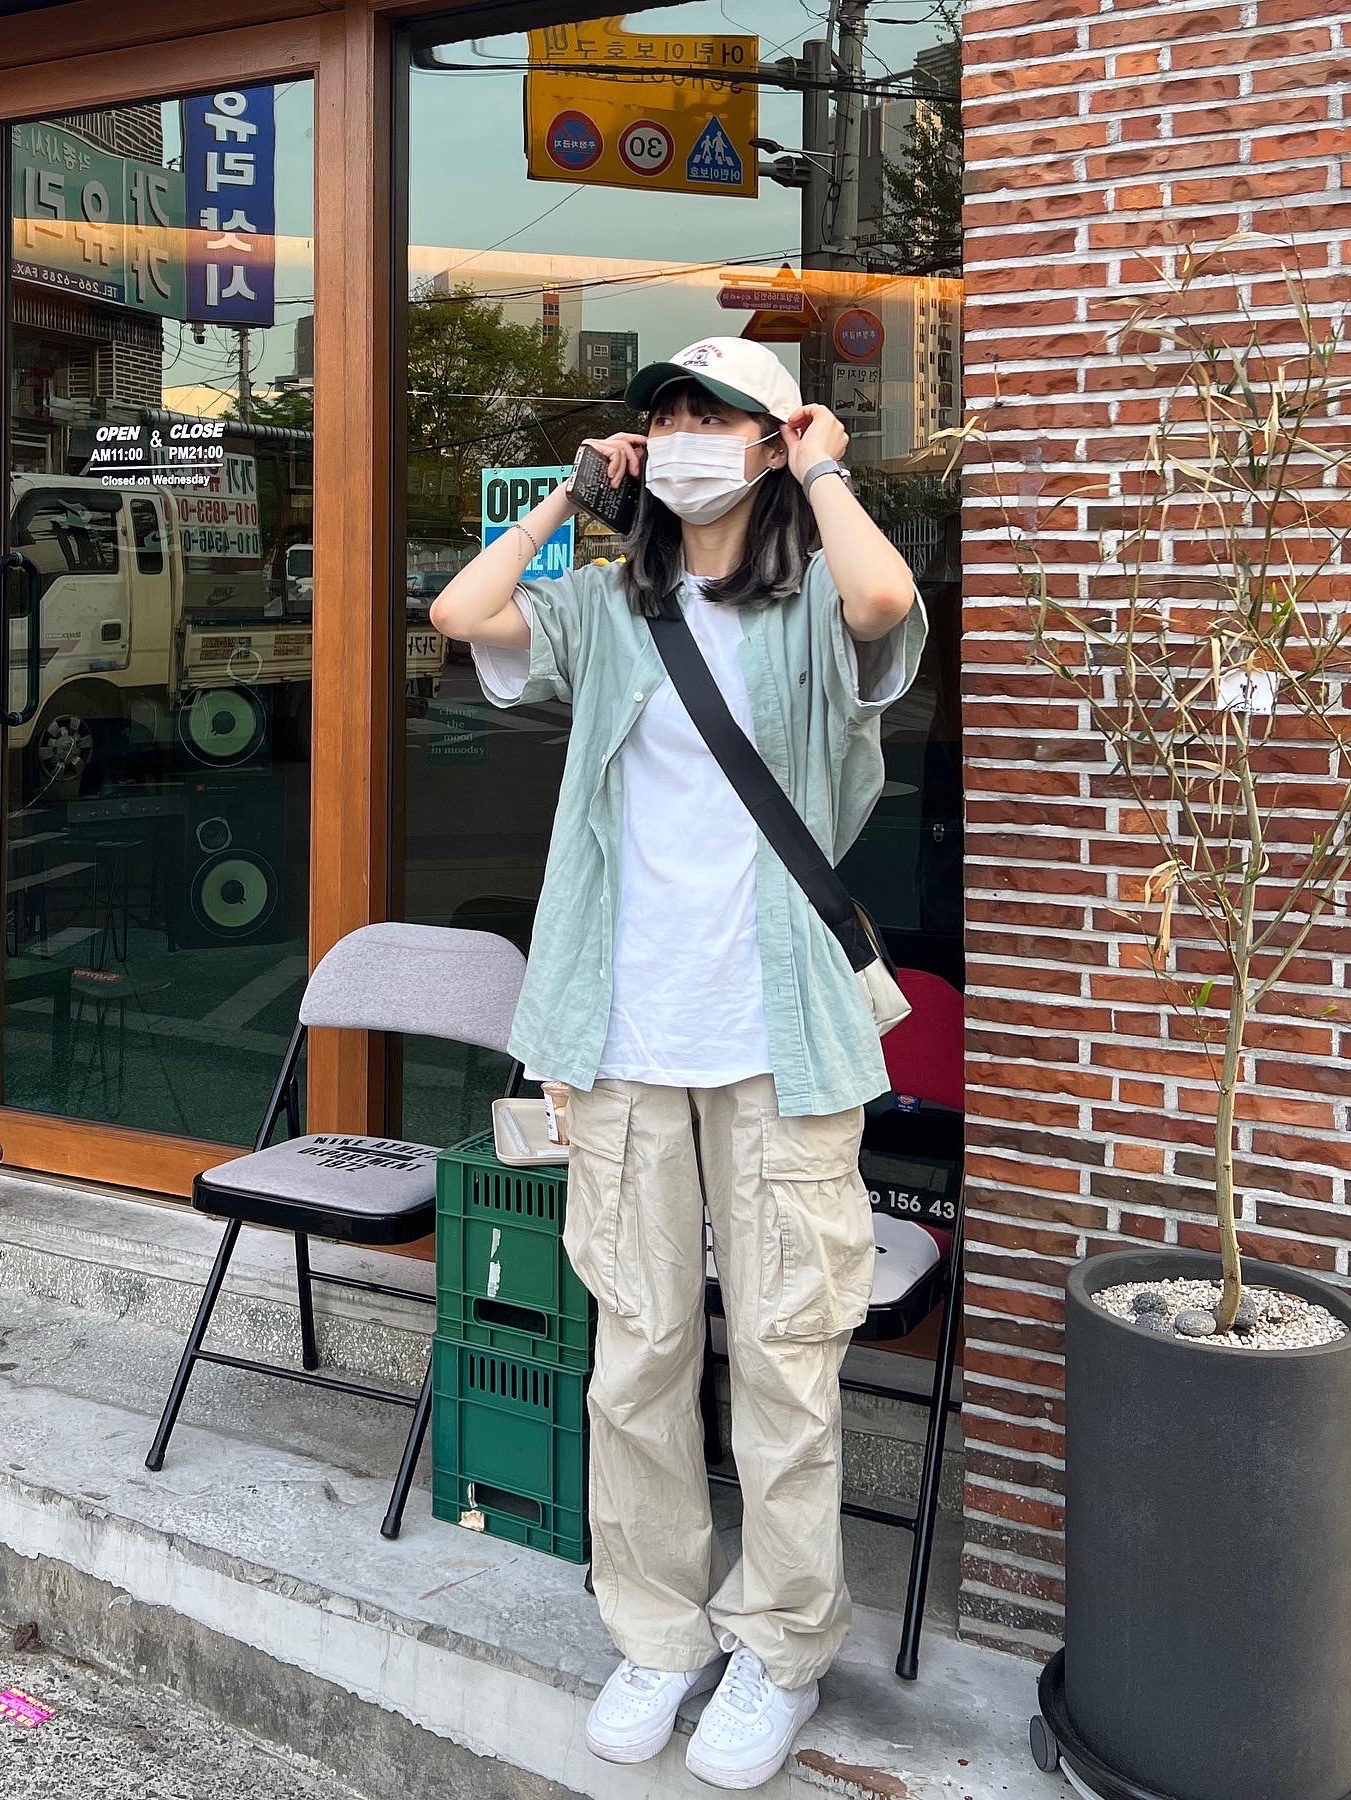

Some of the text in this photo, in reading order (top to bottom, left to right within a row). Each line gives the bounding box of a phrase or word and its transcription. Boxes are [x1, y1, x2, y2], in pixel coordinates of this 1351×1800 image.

[96, 422, 225, 447] OPEN & CLOSE
[90, 445, 223, 461] AM11:00 PM21:00
[101, 474, 210, 486] Closed on Wednesday
[547, 543, 568, 571] IN
[447, 720, 465, 729] the
[444, 732, 473, 741] mood
[431, 746, 441, 754] in
[313, 1137, 367, 1145] NIKE
[297, 1147, 426, 1171] DEPARTMENT
[889, 1190, 921, 1212] 156
[929, 1200, 955, 1219] 43
